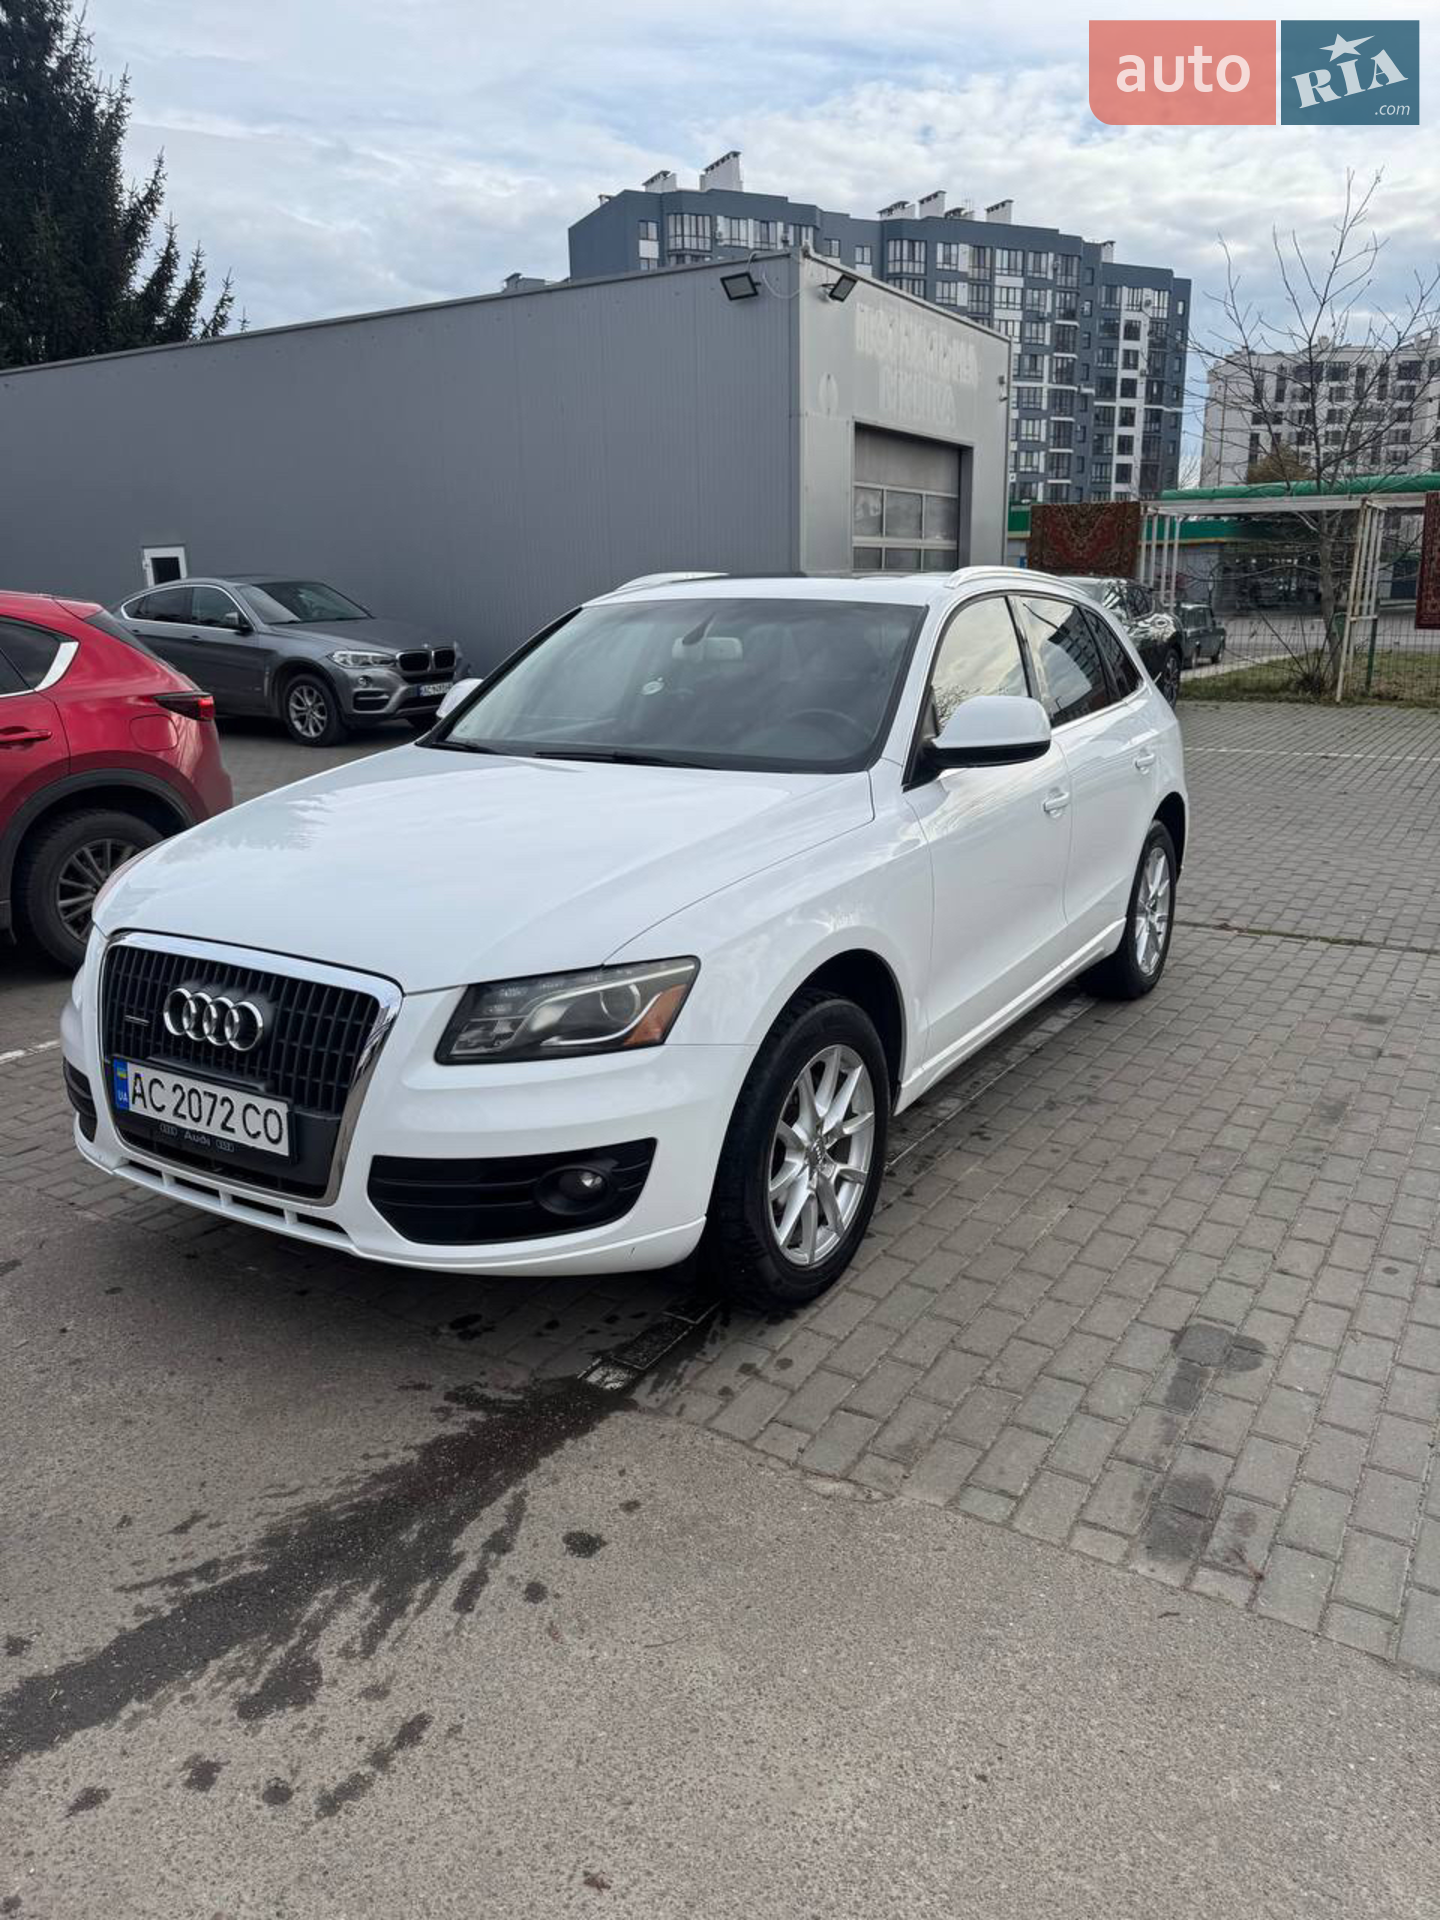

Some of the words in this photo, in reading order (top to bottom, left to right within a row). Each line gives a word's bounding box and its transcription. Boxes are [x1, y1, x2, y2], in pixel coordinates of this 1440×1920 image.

[118, 1091, 129, 1104] UA
[132, 1072, 166, 1114] AC
[172, 1084, 235, 1133] 2072
[242, 1103, 283, 1145] CO
[184, 1131, 211, 1146] Audi
